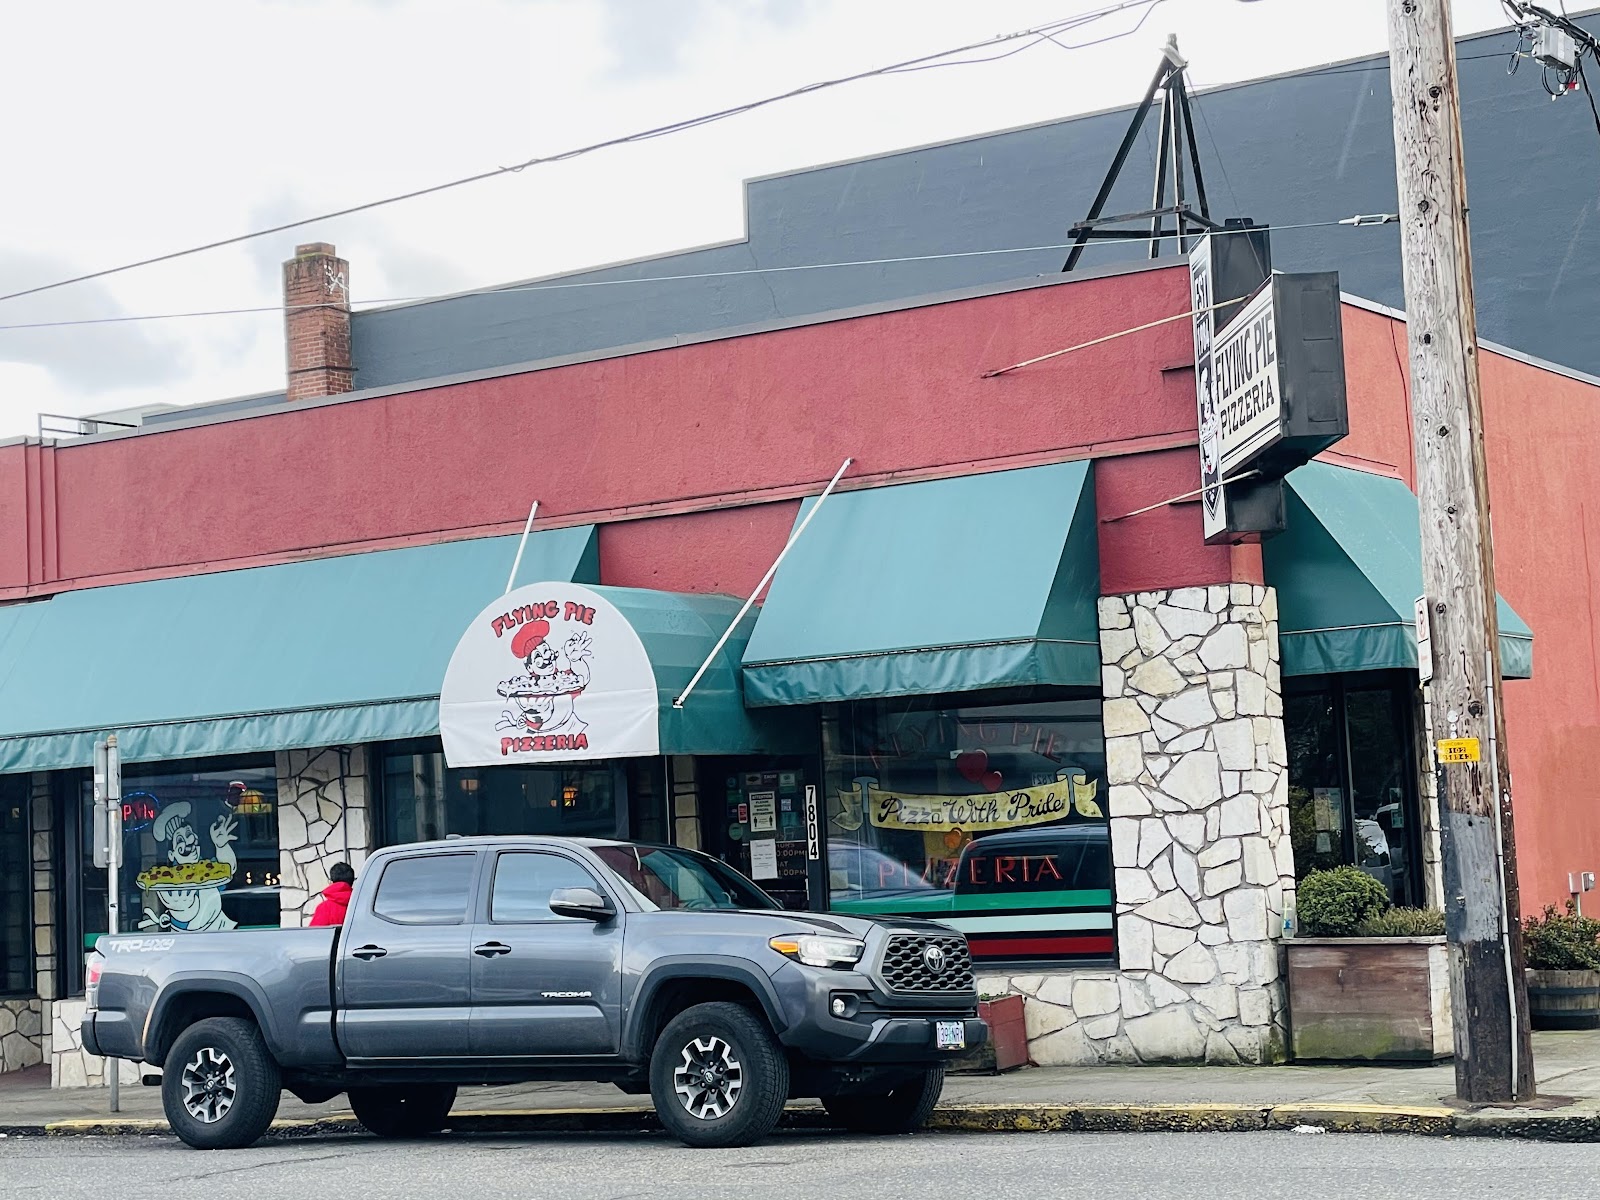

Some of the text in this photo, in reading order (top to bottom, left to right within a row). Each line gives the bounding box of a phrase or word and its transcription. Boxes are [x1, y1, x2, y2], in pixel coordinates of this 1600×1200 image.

[1215, 310, 1275, 404] FLYING PIE
[1219, 375, 1275, 441] PIZZERIA
[491, 600, 596, 638] FLYING PIE
[501, 734, 588, 755] PIZZERIA
[807, 786, 818, 859] 7804
[877, 791, 1065, 825] Pizza With Pride
[878, 854, 1064, 888] PIZZERIA
